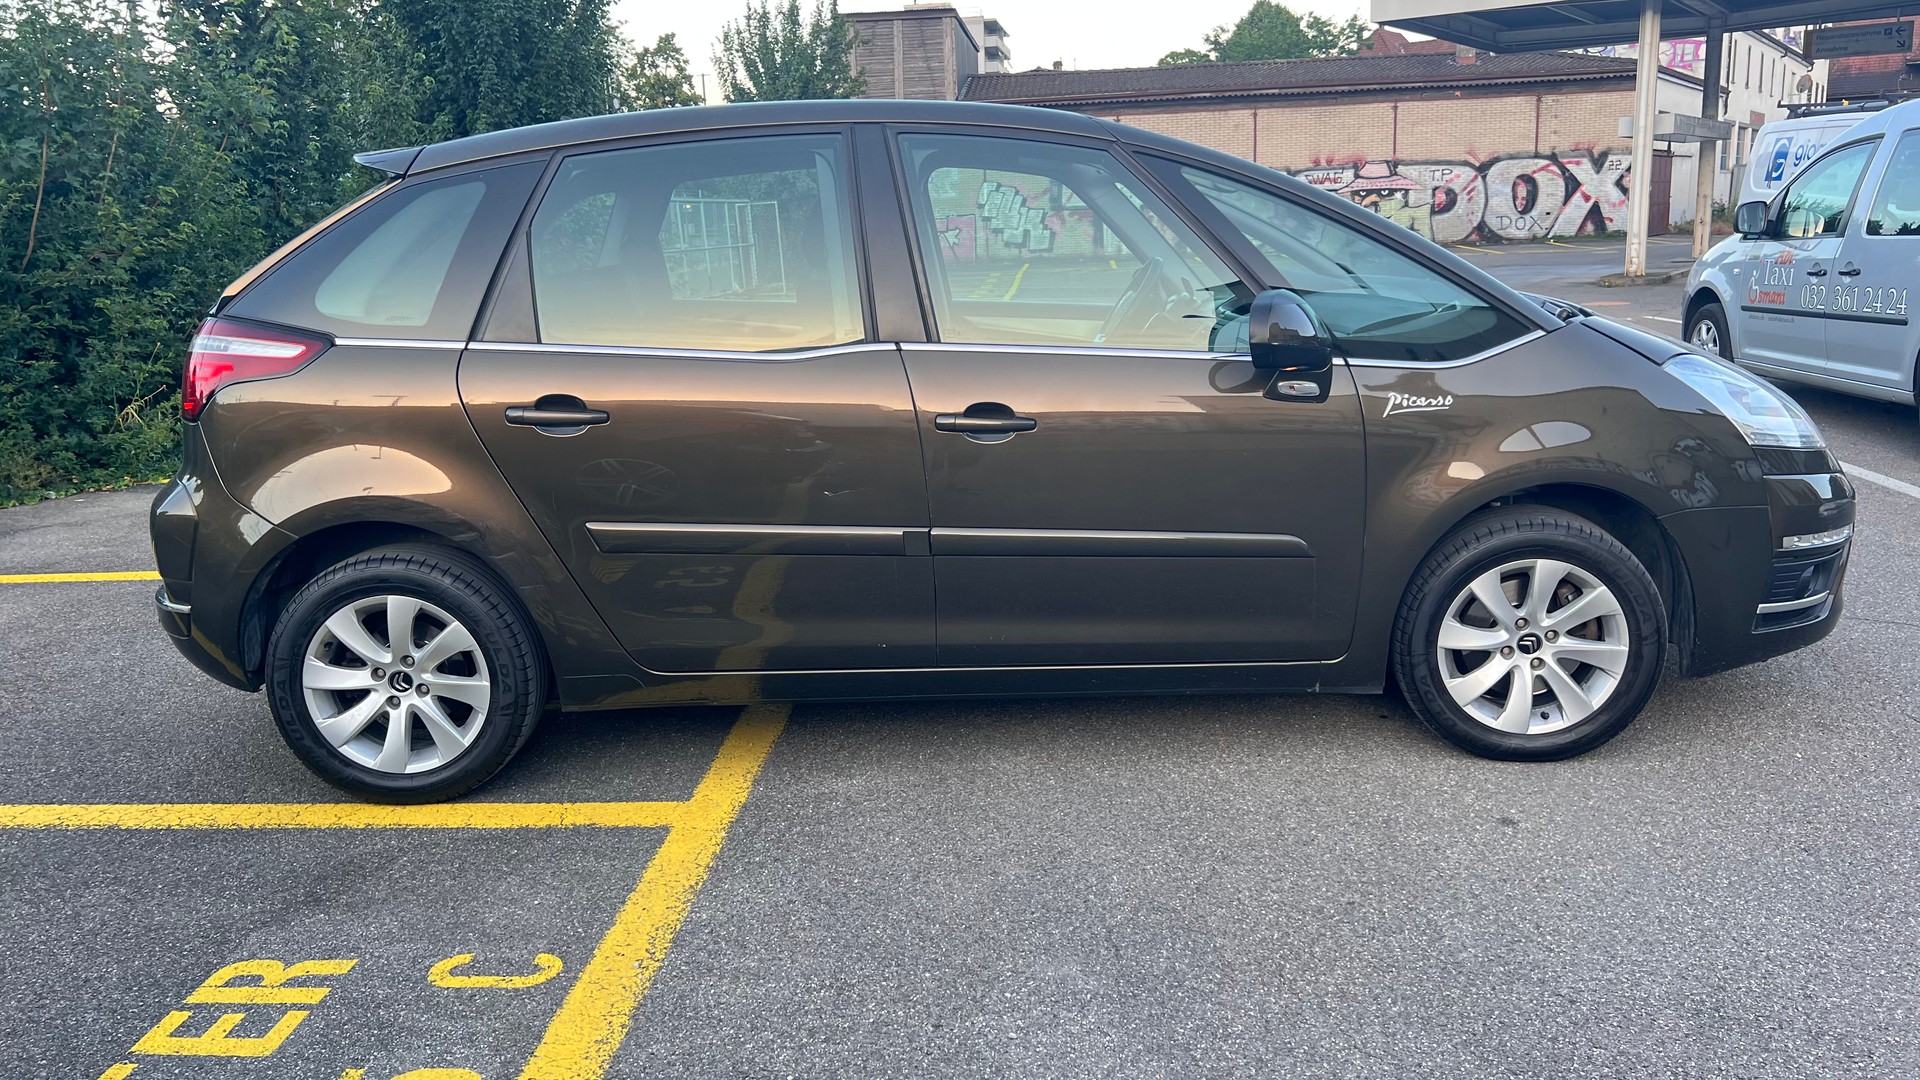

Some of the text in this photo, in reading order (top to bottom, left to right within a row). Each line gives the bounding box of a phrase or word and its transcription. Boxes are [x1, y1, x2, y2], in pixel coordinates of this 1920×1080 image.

[1793, 139, 1827, 167] gio
[1763, 258, 1796, 286] Taxi
[1800, 284, 1908, 316] 032 361 24 24
[1382, 392, 1454, 418] Picasso
[96, 958, 360, 1080] ER
